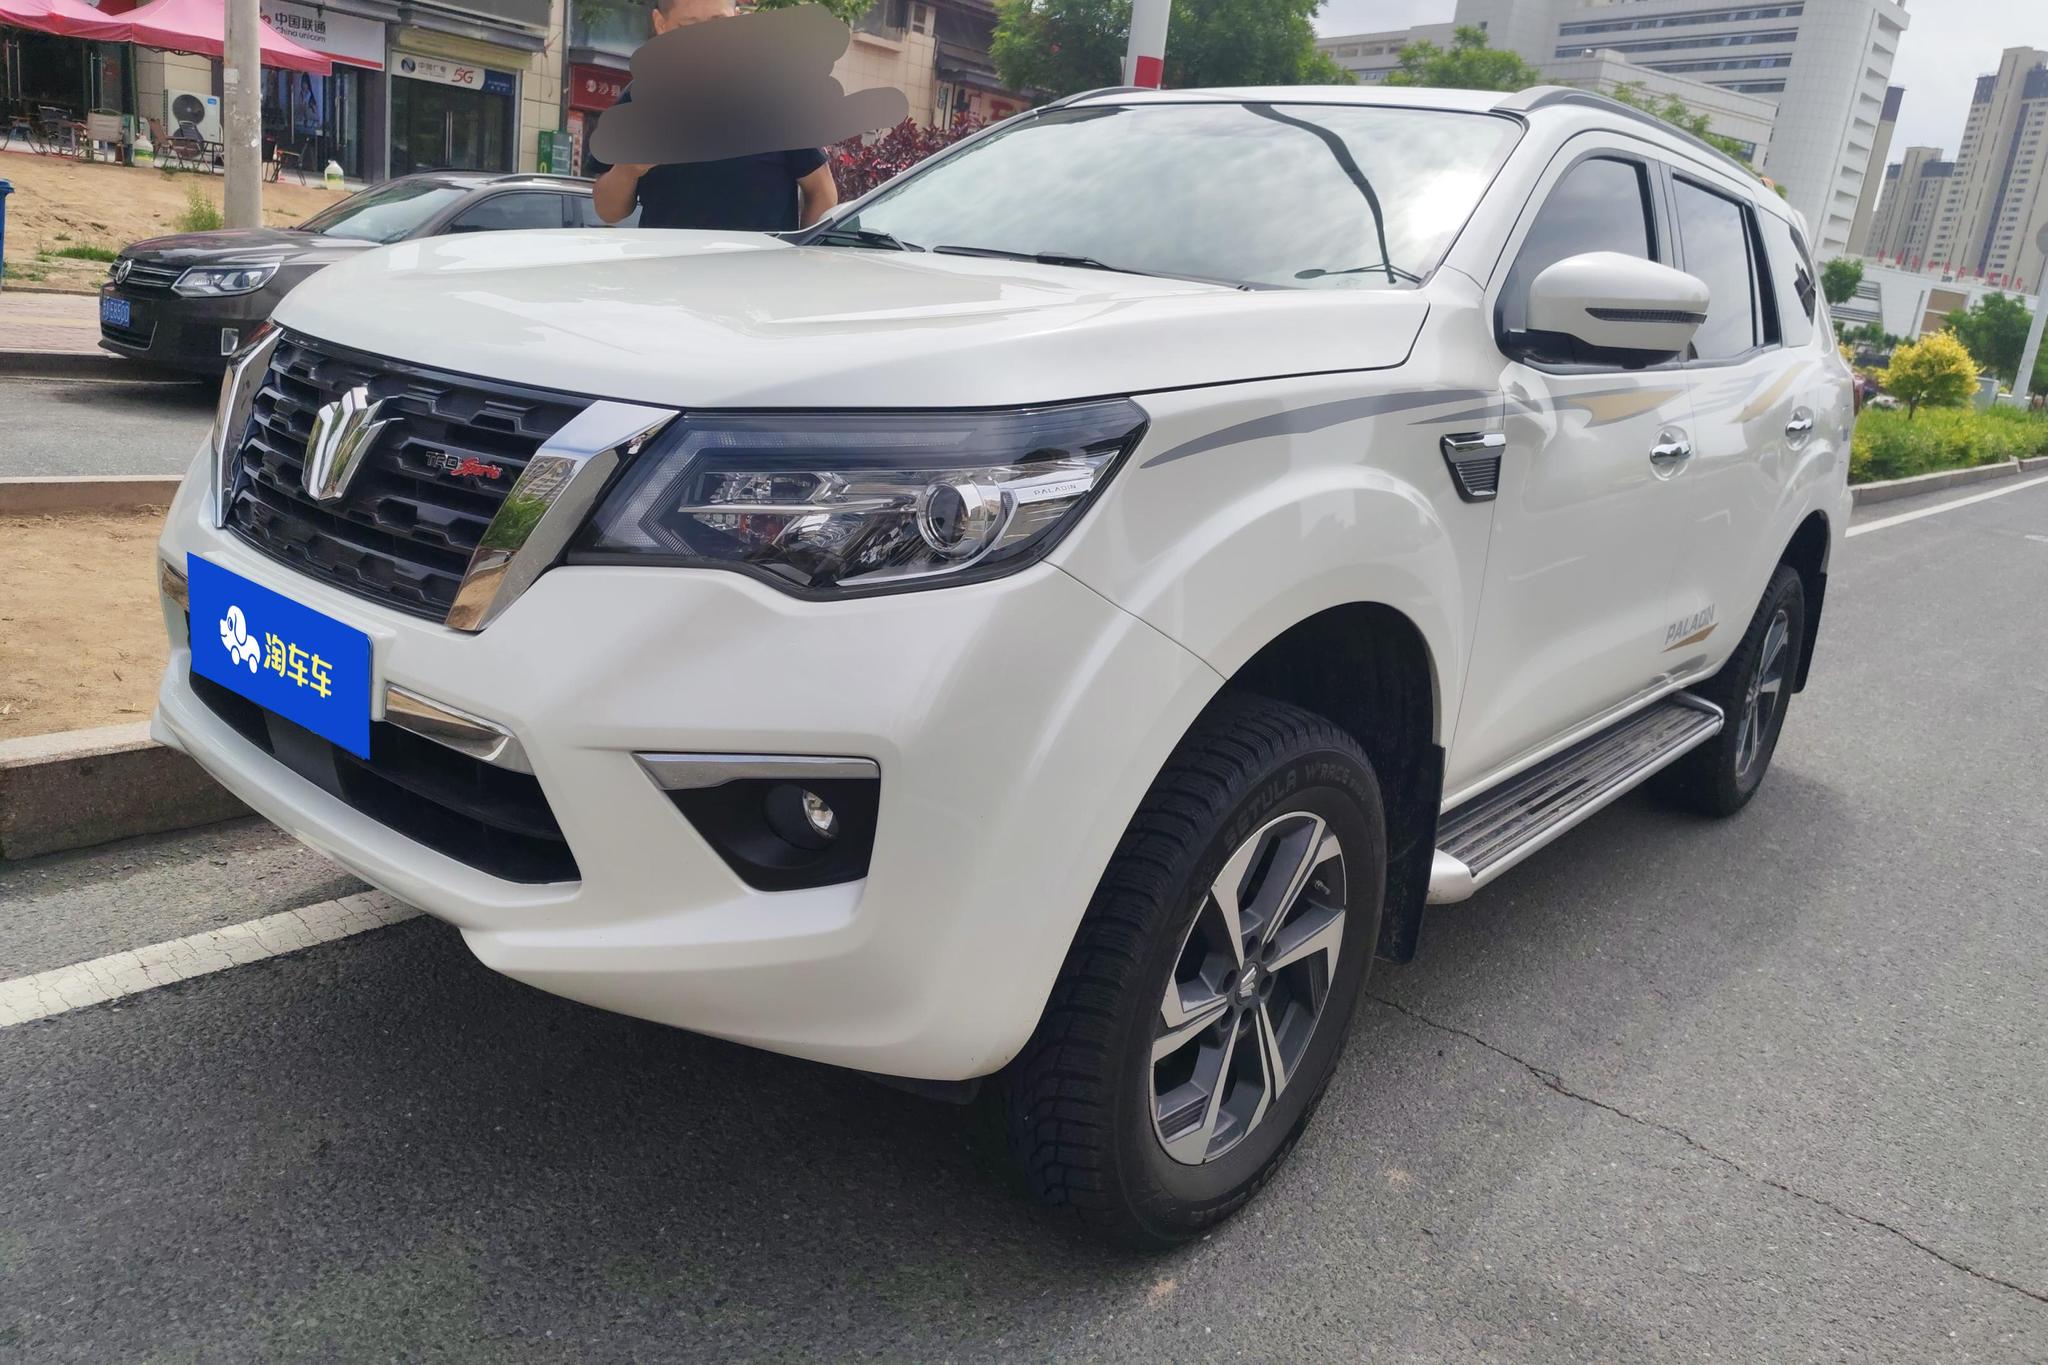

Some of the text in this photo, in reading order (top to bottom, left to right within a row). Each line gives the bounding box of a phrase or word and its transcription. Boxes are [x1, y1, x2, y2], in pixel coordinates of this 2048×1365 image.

[275, 11, 326, 34] 中国联通
[298, 31, 326, 43] unicom
[451, 66, 475, 84] 5G
[426, 450, 460, 470] TRD
[1033, 483, 1077, 496] PALADIN
[1223, 769, 1297, 853] SETULA
